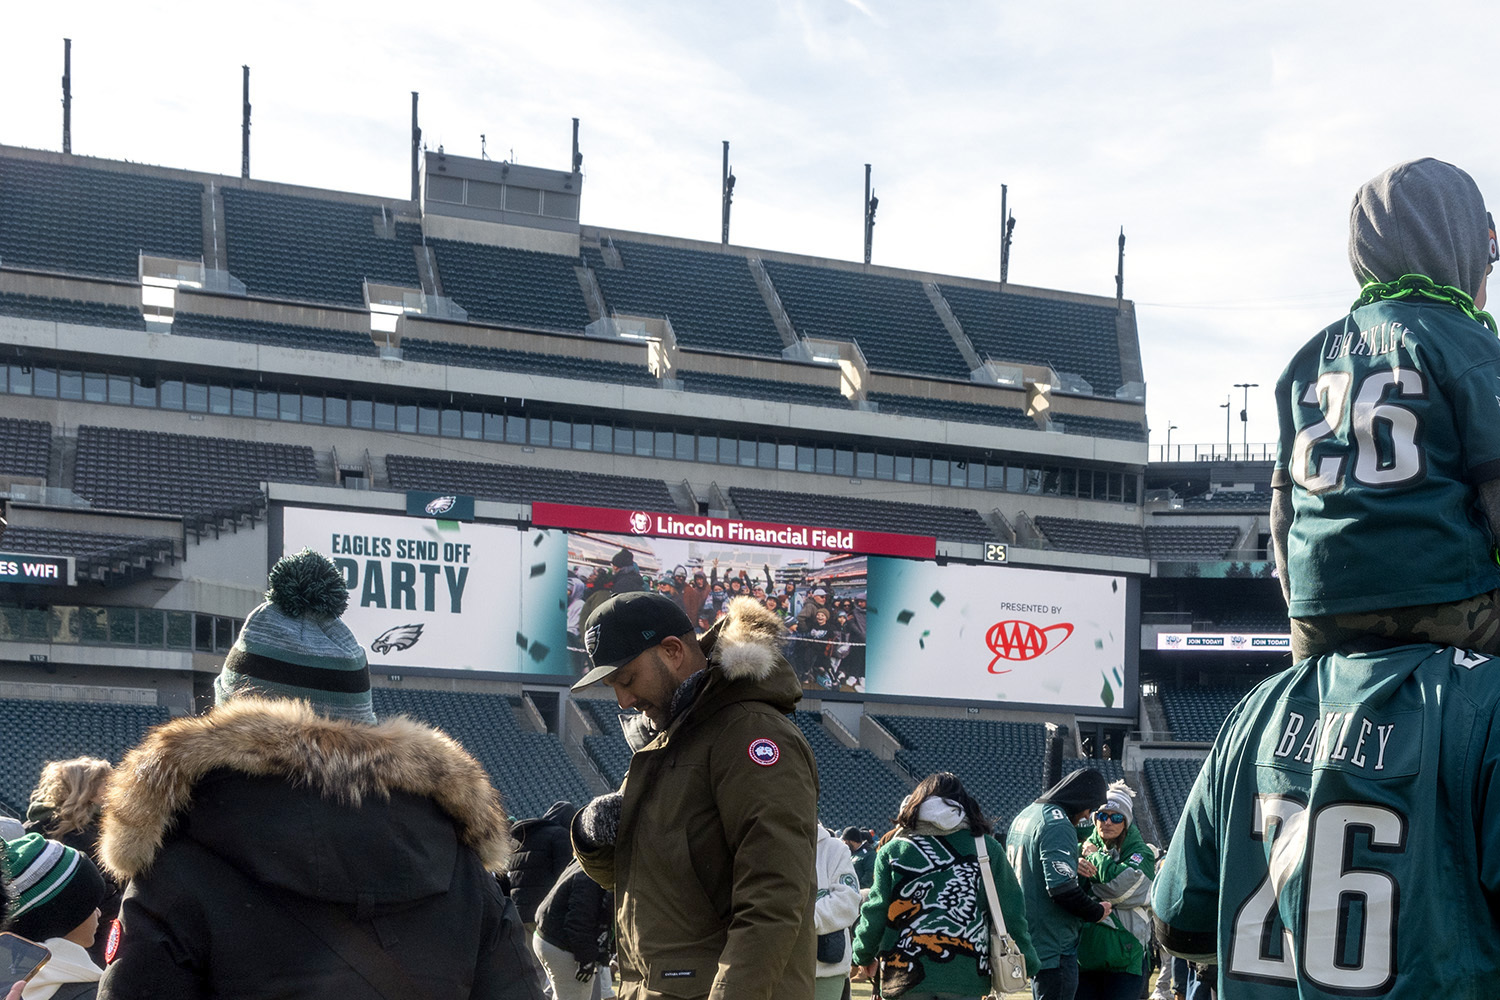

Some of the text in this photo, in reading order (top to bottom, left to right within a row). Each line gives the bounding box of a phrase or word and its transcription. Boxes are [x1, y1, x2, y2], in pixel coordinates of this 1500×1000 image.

[1292, 366, 1428, 493] 26
[332, 533, 471, 564] EAGLES SEND OFF
[657, 516, 854, 549] Lincoln Financial Field
[987, 545, 1006, 561] 25
[22, 562, 58, 578] WIFI
[333, 557, 470, 614] PARTY
[1000, 602, 1062, 614] PRESENTED BY
[990, 621, 1042, 660] AAA
[1228, 792, 1407, 996] 26
